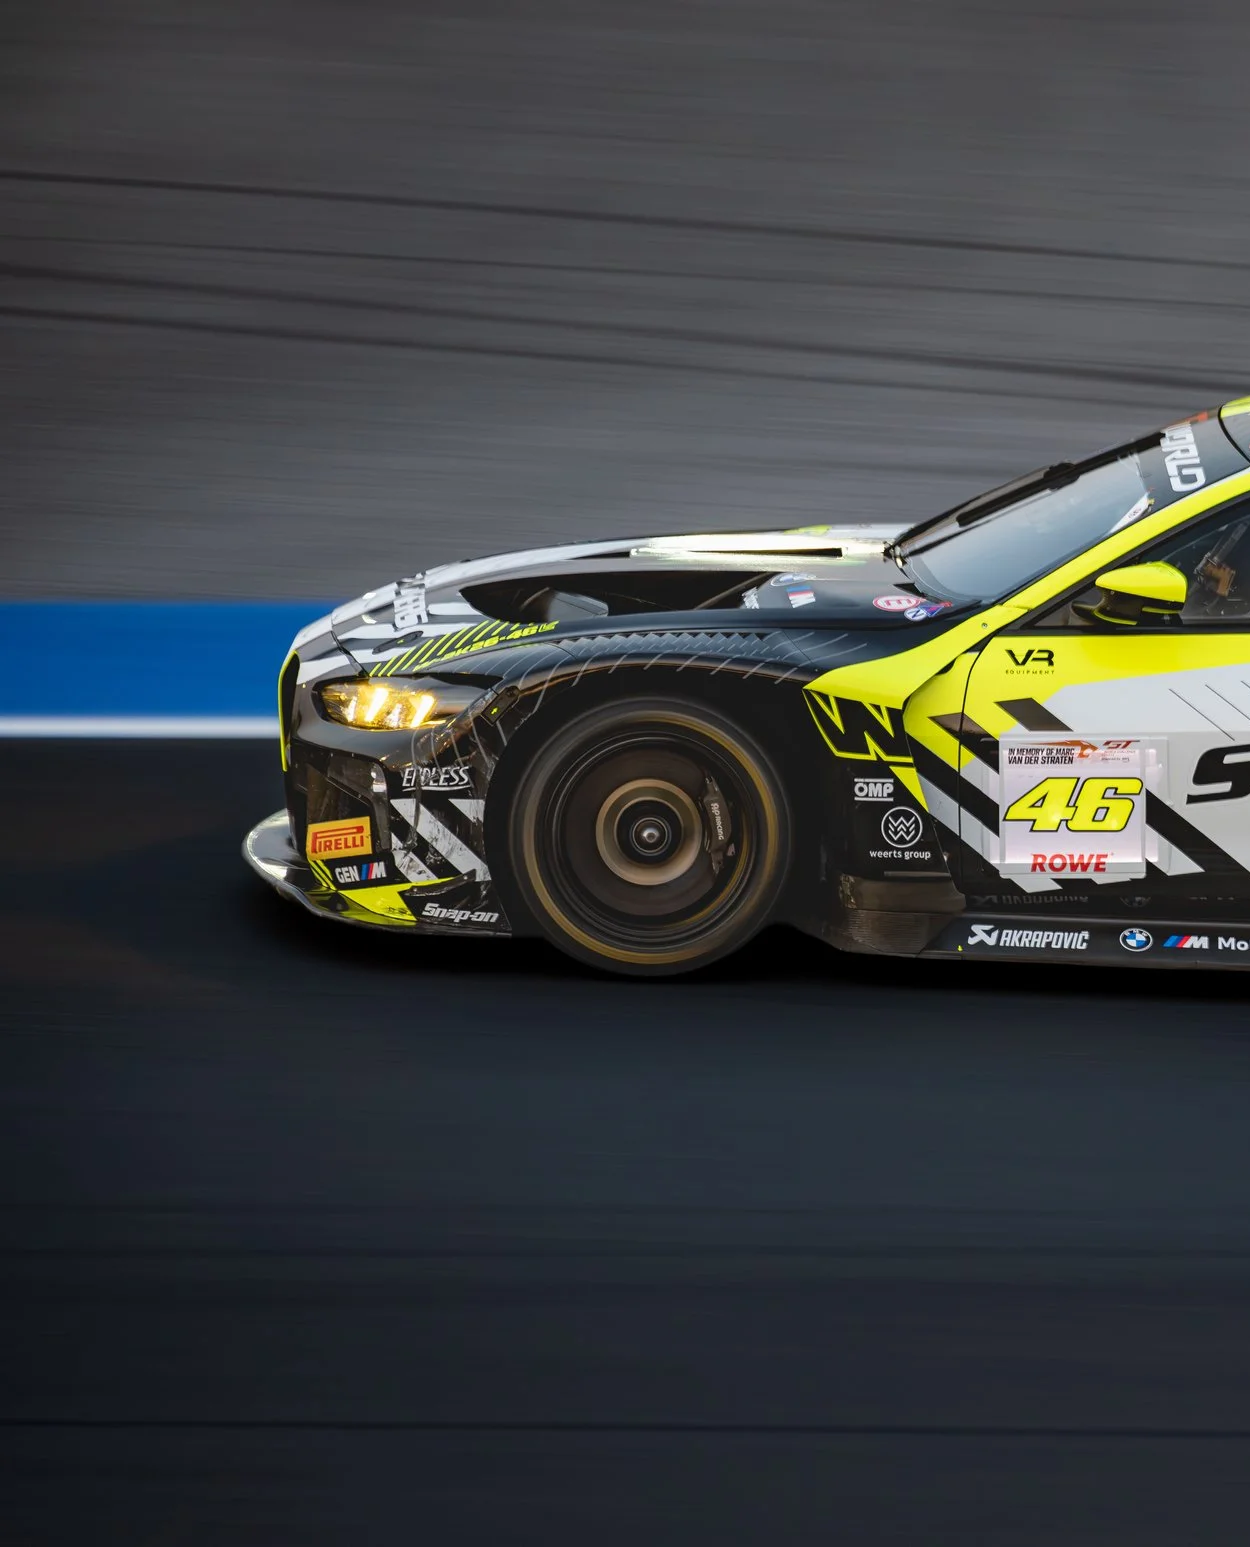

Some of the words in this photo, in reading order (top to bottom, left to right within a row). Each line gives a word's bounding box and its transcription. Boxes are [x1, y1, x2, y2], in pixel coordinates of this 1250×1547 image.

[1005, 649, 1054, 667] VR
[1008, 748, 1016, 756] IN
[1016, 748, 1045, 756] MEMORY
[1046, 748, 1056, 756] OF
[1056, 748, 1075, 756] MARC
[1008, 756, 1023, 765] VAN
[1024, 756, 1041, 765] DER
[1041, 756, 1074, 765] STRATEN
[854, 781, 894, 799] OMP
[1003, 777, 1143, 832] 46
[310, 825, 365, 854] PIRELLI
[870, 849, 902, 859] weerts
[904, 850, 931, 860] group
[1031, 854, 1109, 872] ROWE
[335, 865, 360, 883] GEN
[422, 902, 500, 923] Snap-on
